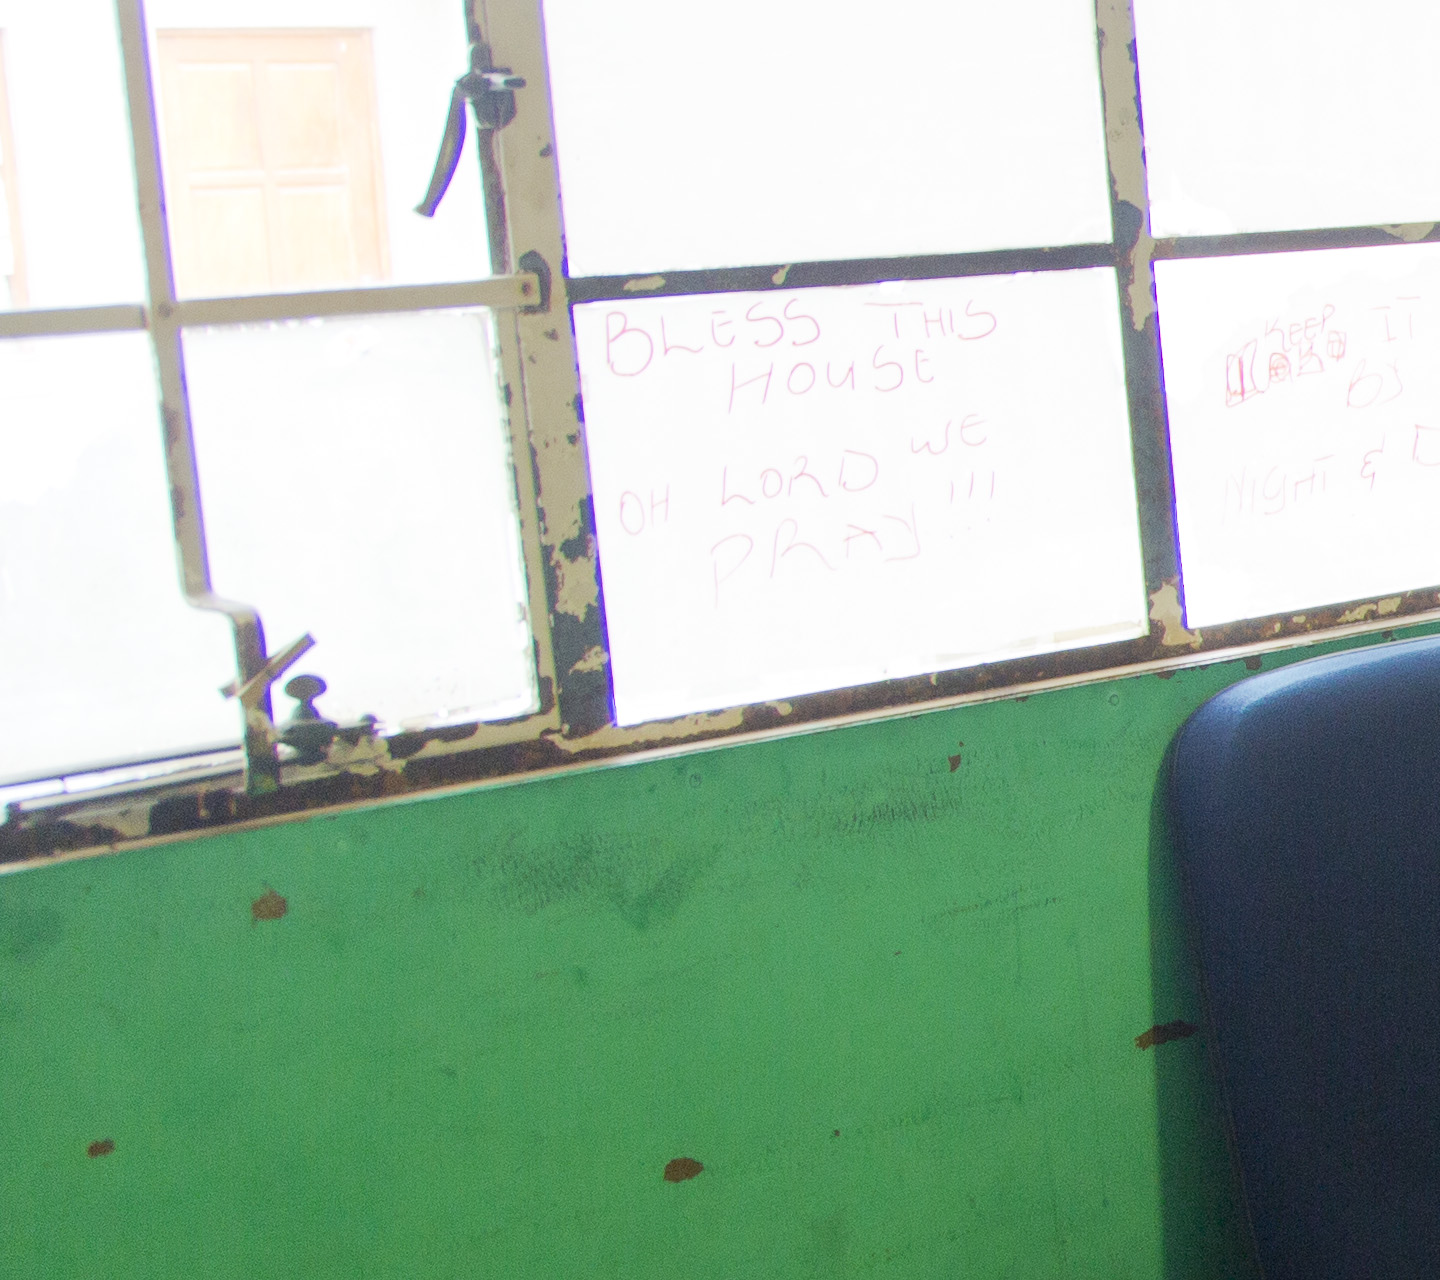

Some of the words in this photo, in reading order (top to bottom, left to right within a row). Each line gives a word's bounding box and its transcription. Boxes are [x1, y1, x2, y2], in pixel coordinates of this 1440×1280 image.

[604, 297, 821, 377] BLESS
[862, 299, 998, 341] THIS
[1264, 303, 1336, 354] KEEP
[1370, 295, 1421, 342] IT
[727, 343, 934, 413] HOUSE
[619, 482, 670, 537] OH
[720, 449, 879, 506] LORD
[910, 412, 988, 456] WE
[1222, 454, 1335, 526] NIGHT
[710, 501, 922, 610] PRAY
